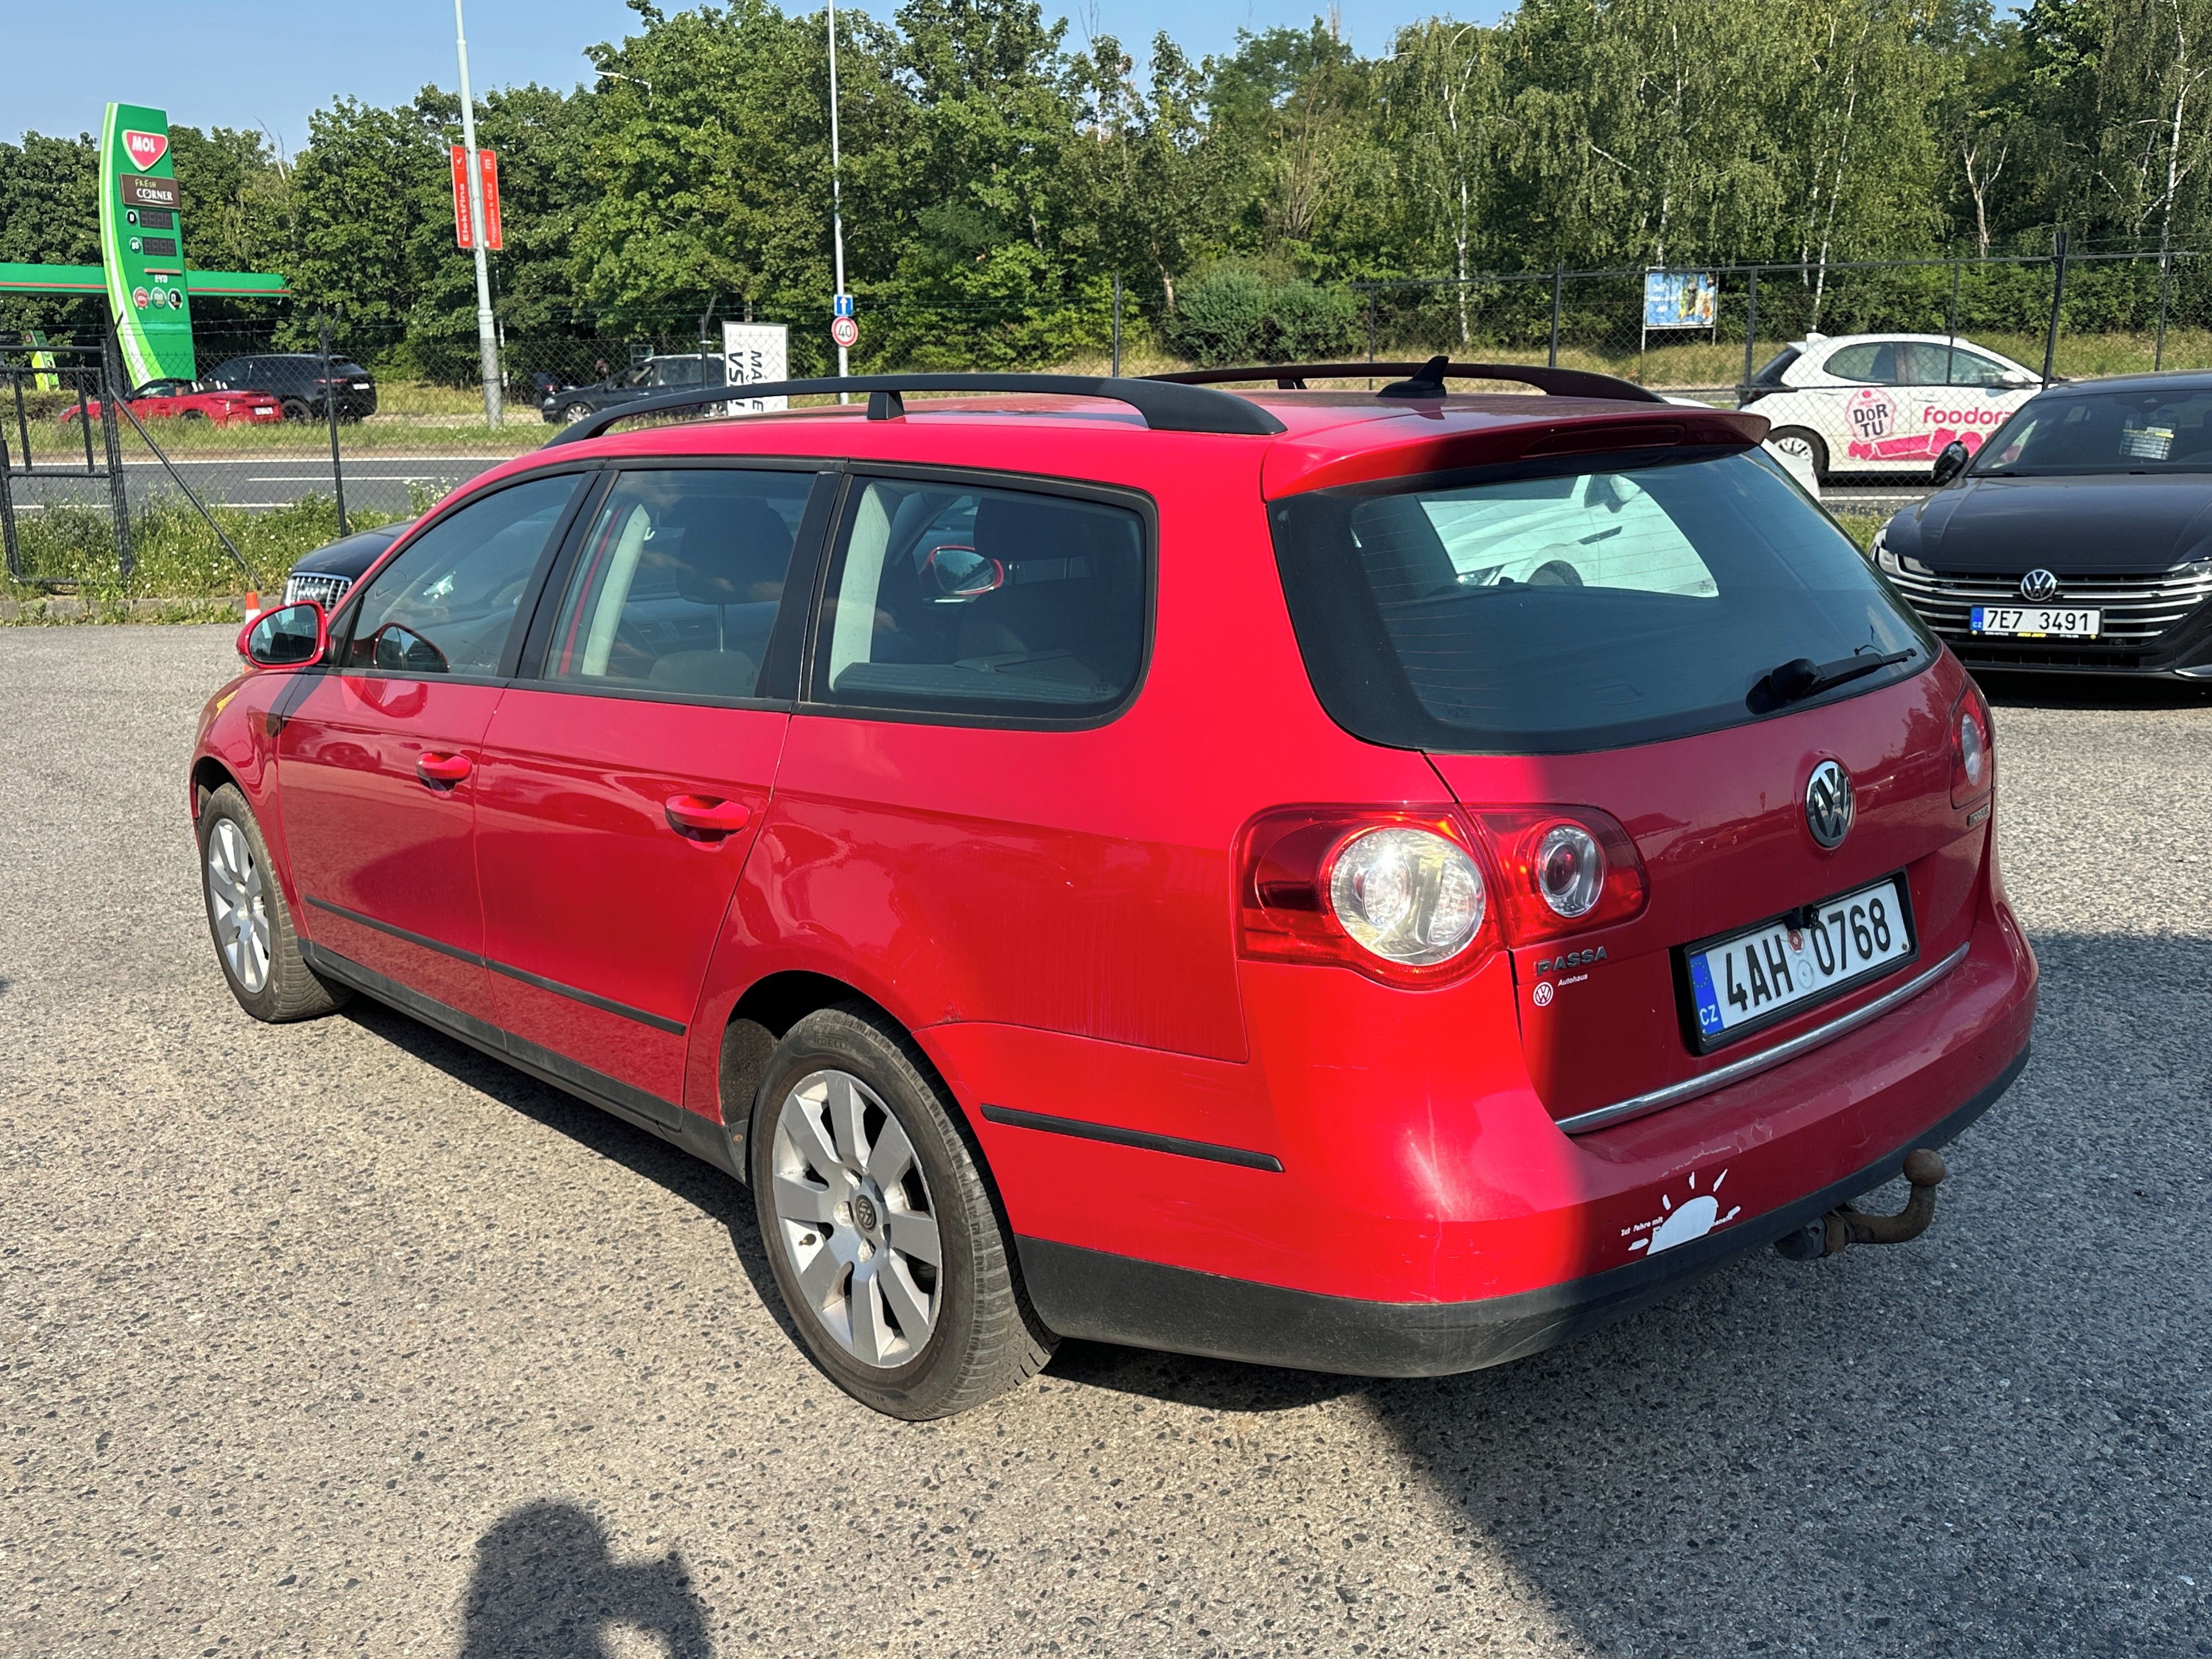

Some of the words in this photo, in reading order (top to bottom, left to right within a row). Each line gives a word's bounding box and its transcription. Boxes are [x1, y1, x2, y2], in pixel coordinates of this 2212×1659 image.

[132, 136, 156, 153] MOL
[136, 188, 173, 201] CORNER
[459, 183, 470, 242] Elektřina
[838, 325, 852, 337] 40
[729, 352, 749, 408] VŠ!
[751, 350, 768, 413] MÁE
[1860, 420, 1884, 438] TU
[1988, 610, 2023, 629] 7E7
[2039, 612, 2088, 631] 3491
[1725, 934, 1794, 1012] 4AH
[1810, 898, 1891, 976] 0768
[1558, 974, 1588, 987] Autohaus
[1700, 1003, 1718, 1026] CZ
[1652, 1216, 1663, 1226] mit
